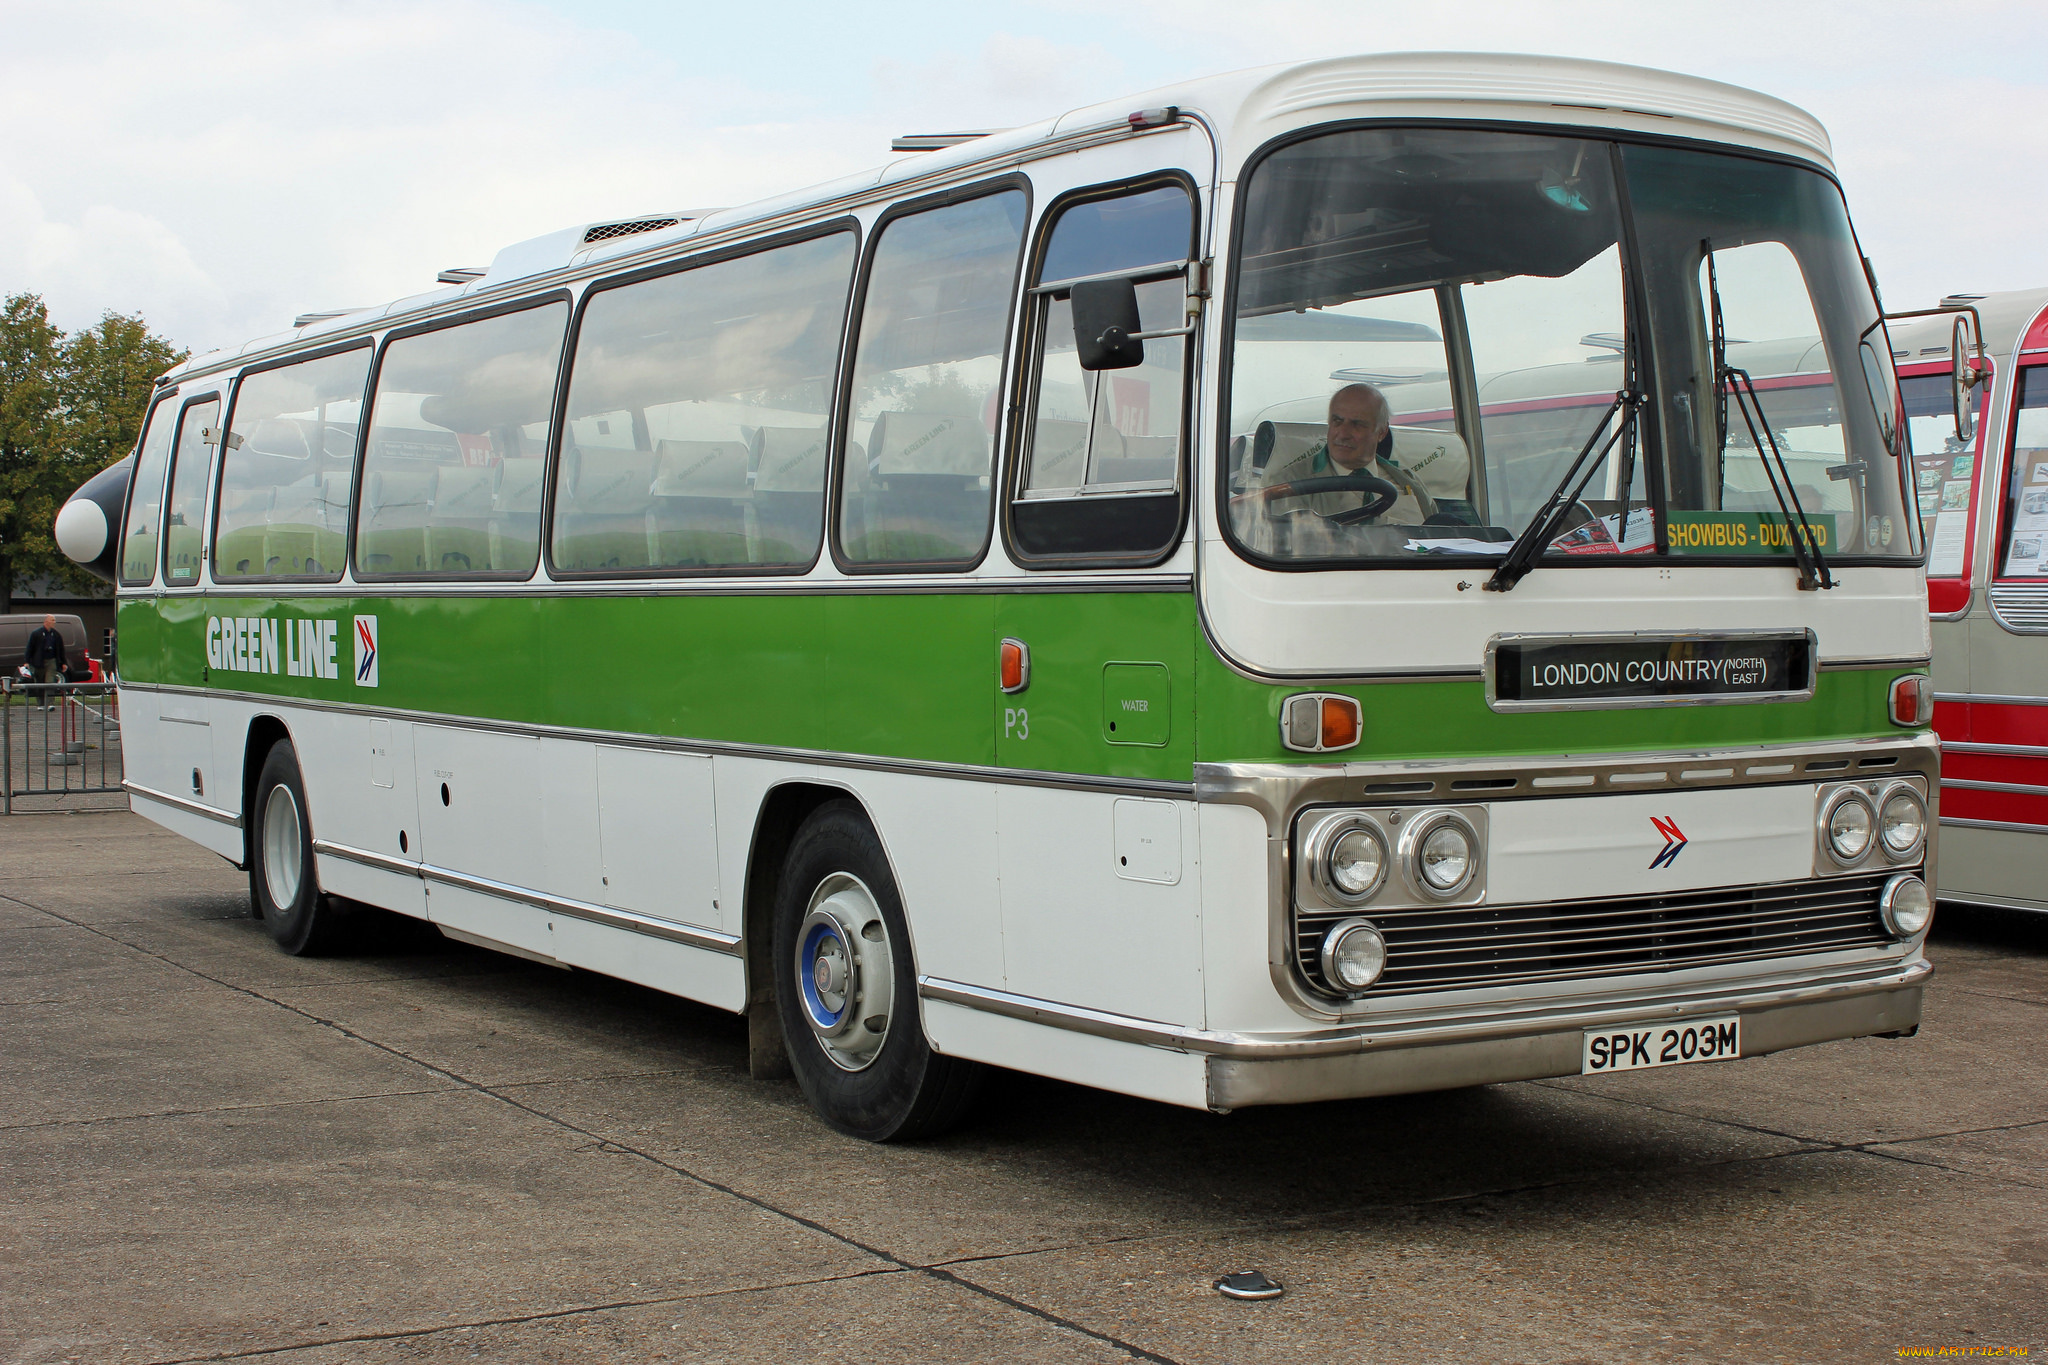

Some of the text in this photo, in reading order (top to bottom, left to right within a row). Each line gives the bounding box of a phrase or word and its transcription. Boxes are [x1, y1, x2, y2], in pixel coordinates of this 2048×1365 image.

[1668, 523, 1748, 547] SHOWBUS
[206, 616, 338, 680] GREEN LINE
[1532, 662, 1620, 687] LONDON
[1625, 659, 1723, 682] COUNTRY
[1121, 699, 1149, 712] WATER
[1004, 708, 1029, 740] P3
[1590, 1022, 1737, 1069] SPK 203M
